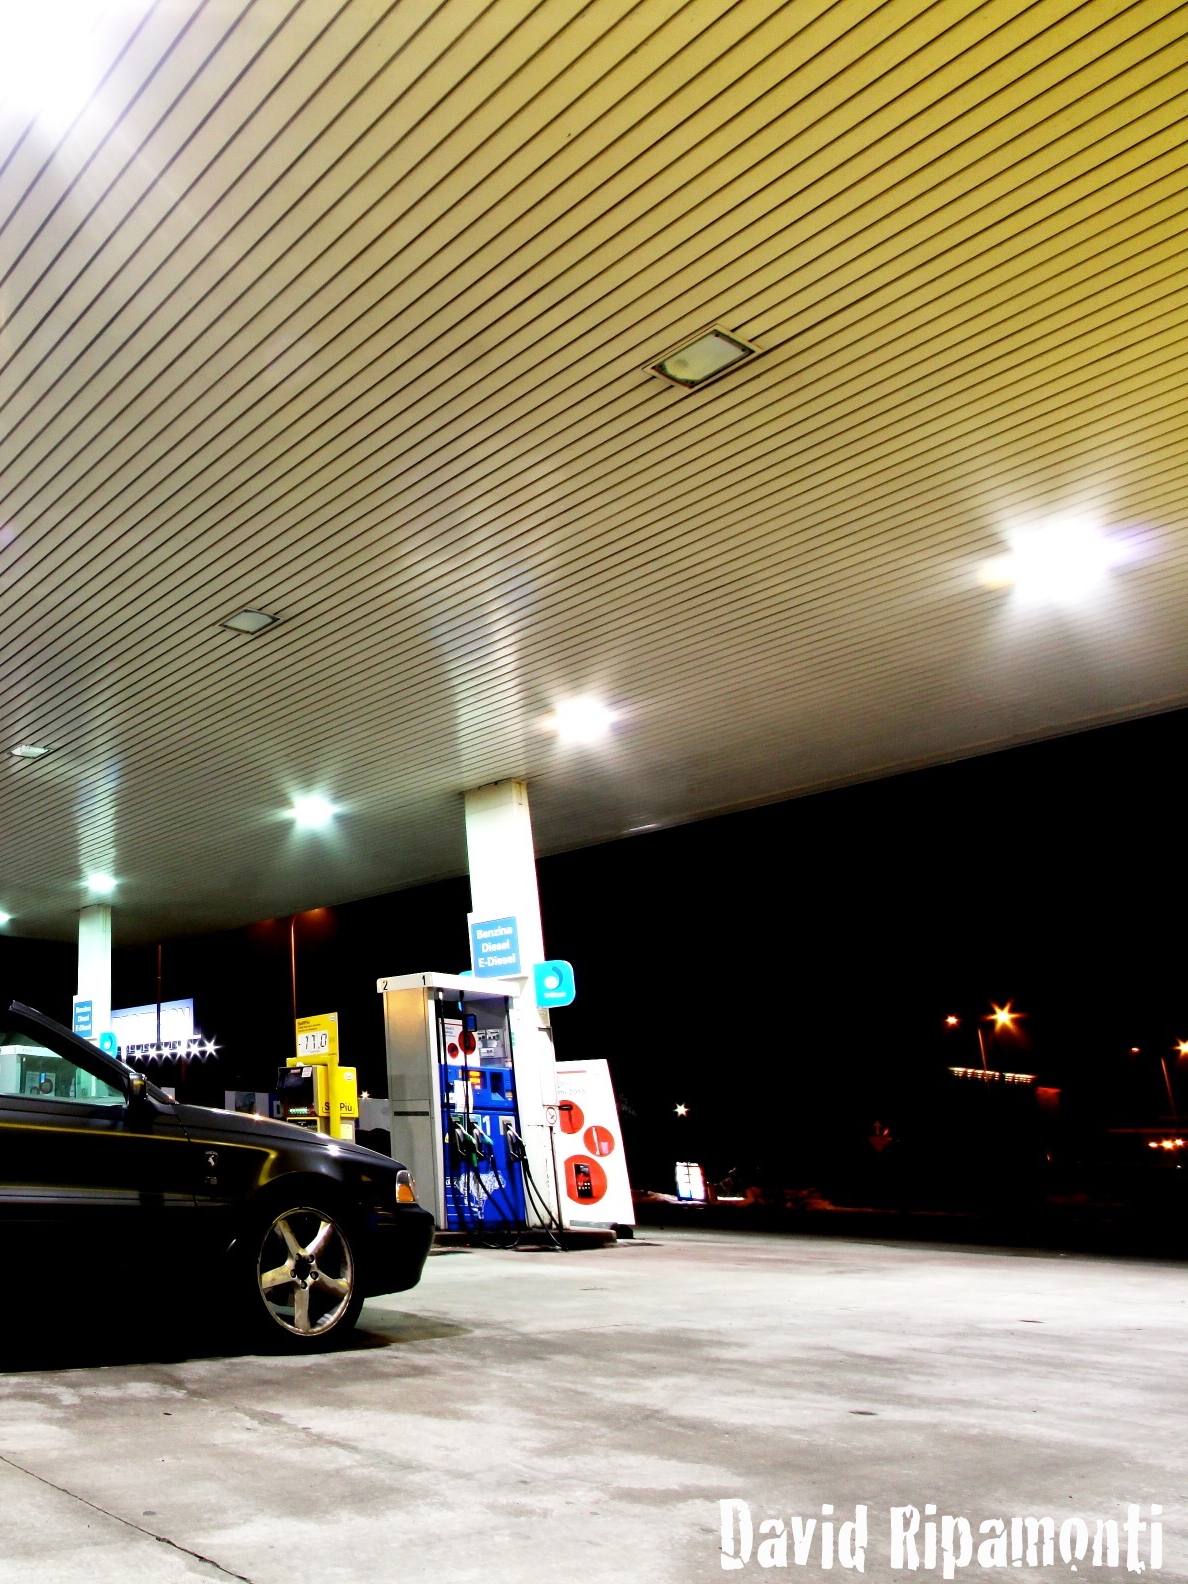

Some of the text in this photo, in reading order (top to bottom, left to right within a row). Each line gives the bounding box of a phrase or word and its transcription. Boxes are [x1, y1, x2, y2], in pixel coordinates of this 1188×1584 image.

[476, 926, 513, 939] Benzina
[481, 939, 510, 953] Diesel
[477, 953, 517, 968] E-Diesel
[382, 980, 389, 991] 2
[422, 975, 426, 986] 1
[482, 1115, 491, 1137] 1
